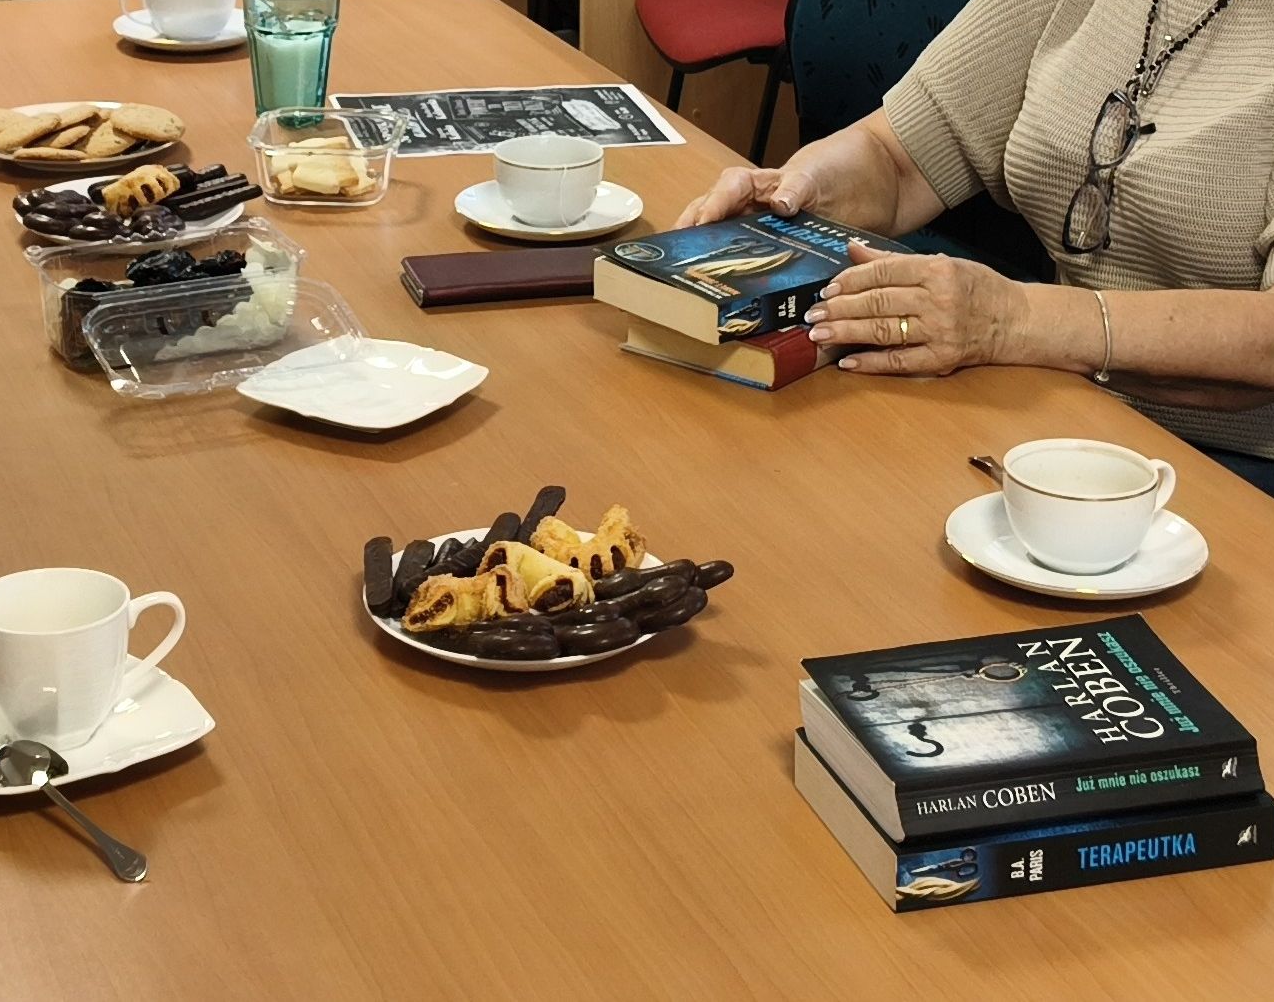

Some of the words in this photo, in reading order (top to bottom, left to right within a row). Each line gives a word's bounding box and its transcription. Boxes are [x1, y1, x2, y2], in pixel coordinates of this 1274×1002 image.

[757, 215, 848, 255] RAPEUTKA
[788, 295, 796, 318] PARIS
[1096, 631, 1144, 675] oszukasz
[1017, 641, 1128, 745] HARLAN
[1045, 637, 1164, 739] COBEN
[1134, 674, 1159, 691] nie
[1150, 691, 1182, 716] mnie
[1076, 776, 1096, 793] Już
[1098, 776, 1126, 790] mnie
[1129, 771, 1148, 786] nie
[1150, 765, 1201, 783] oszukasz
[916, 794, 977, 816] HARLAN
[982, 782, 1057, 809] COBEN
[1029, 849, 1044, 881] PARIS
[1078, 832, 1197, 870] TERAPEUTKA
[1011, 858, 1025, 879] B.A.
